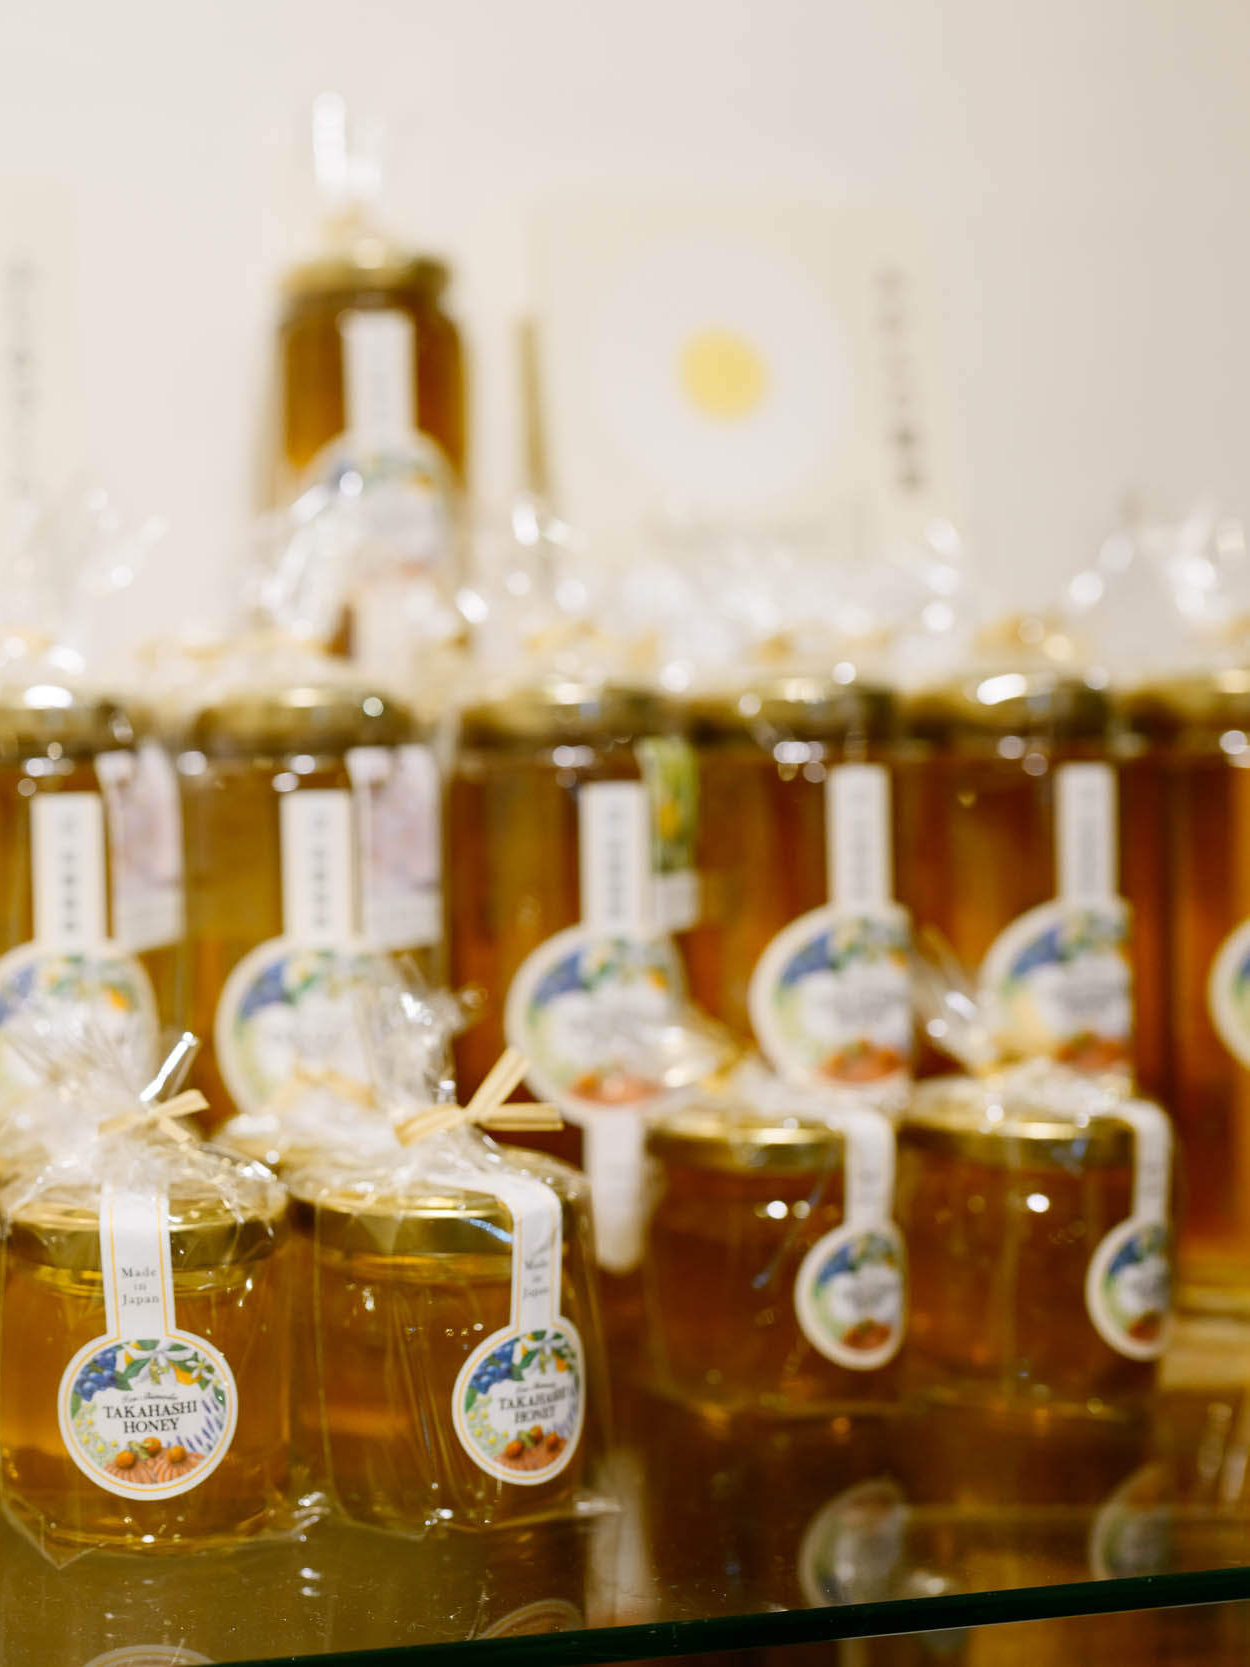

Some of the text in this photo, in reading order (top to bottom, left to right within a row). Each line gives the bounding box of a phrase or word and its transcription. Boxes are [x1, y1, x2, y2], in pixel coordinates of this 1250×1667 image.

[121, 1266, 157, 1278] Made
[121, 1293, 160, 1307] Japan
[102, 1400, 198, 1419] TAKAHASHI
[123, 1416, 179, 1434] HONEY
